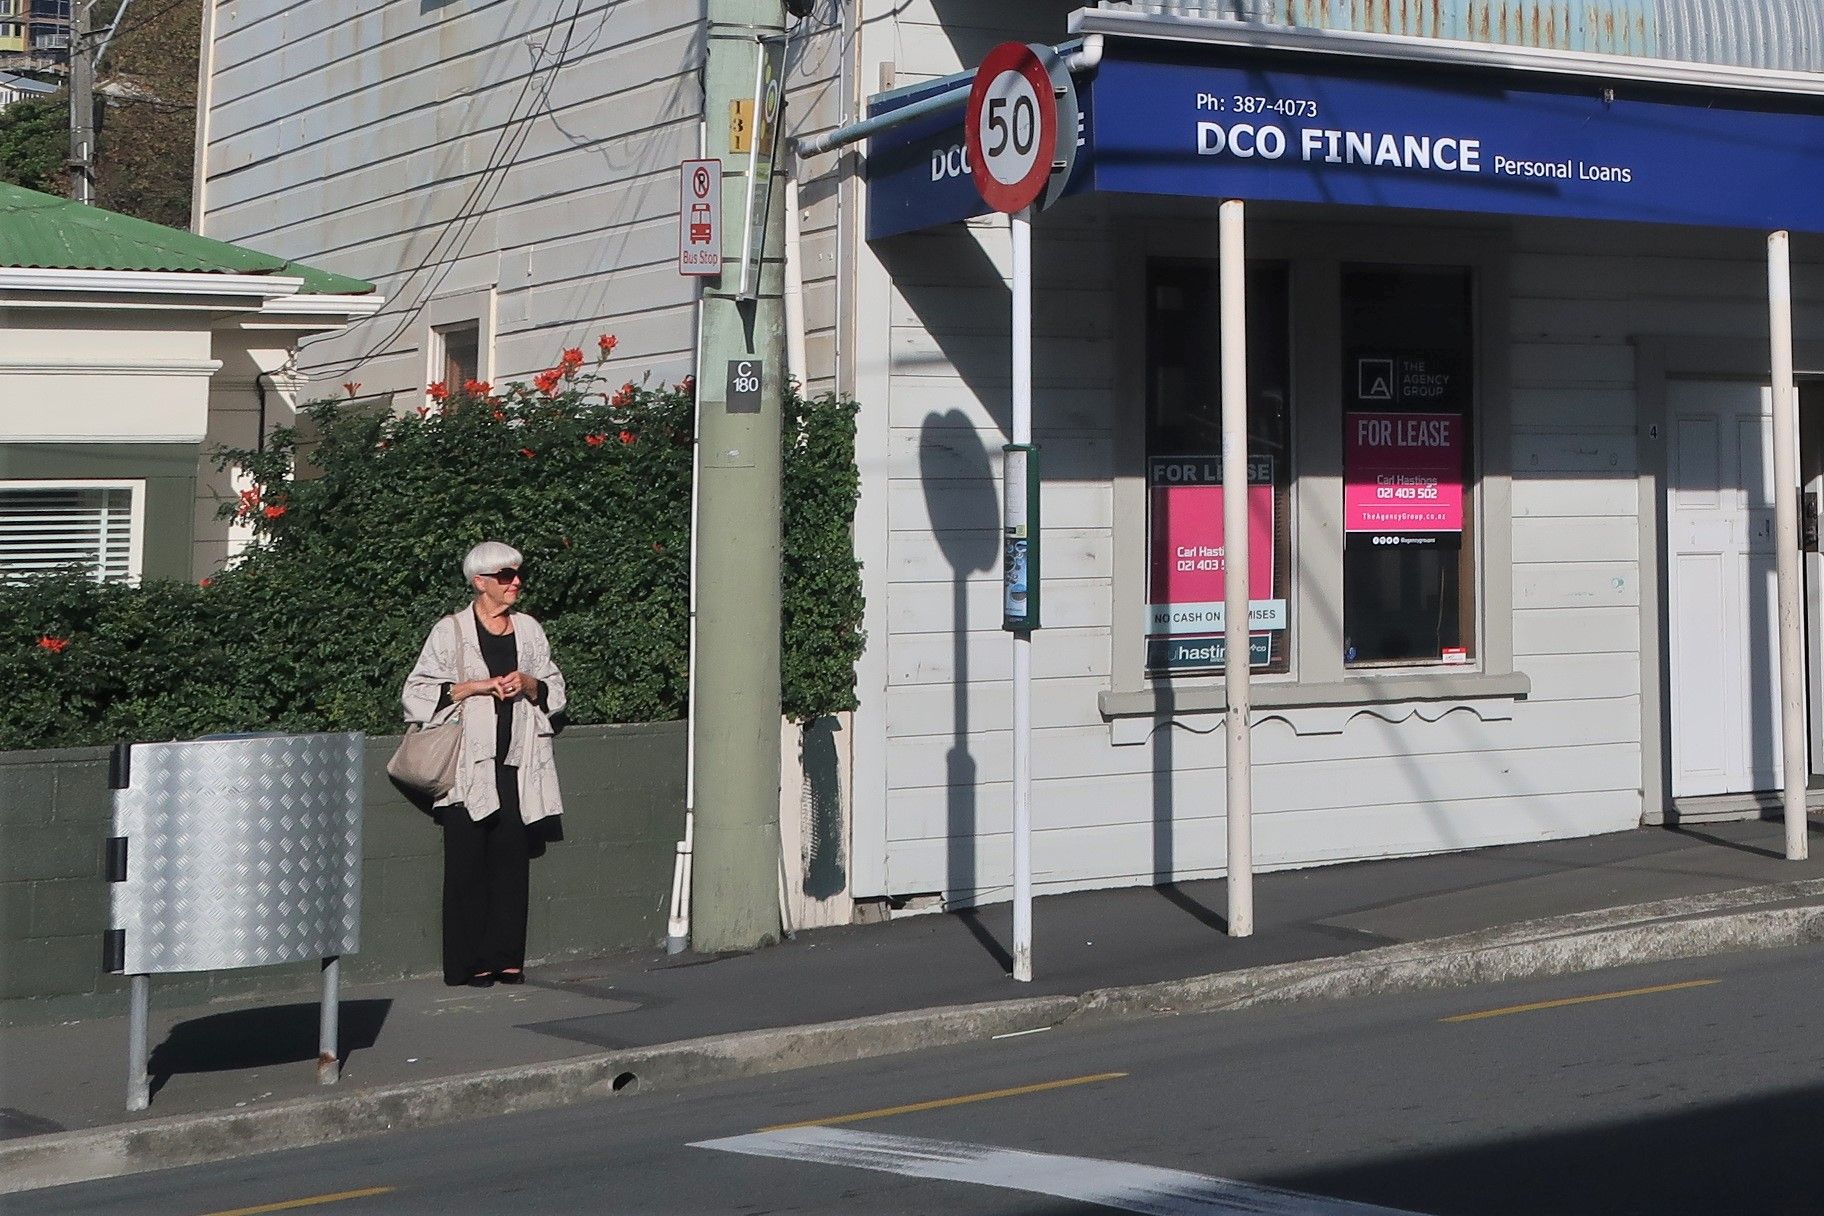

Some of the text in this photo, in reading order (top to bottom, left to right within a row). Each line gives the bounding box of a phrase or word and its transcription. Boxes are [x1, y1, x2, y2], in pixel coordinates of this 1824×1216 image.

[1197, 94, 1317, 117] Ph: 387-4073
[988, 95, 1035, 157] 50
[1197, 121, 1631, 183] DCO FINANCE Personal Loans
[683, 251, 718, 266] Bus Stop
[738, 361, 752, 377] C
[1403, 361, 1425, 372] THE
[733, 377, 759, 393] 180
[1403, 375, 1450, 385] AGENCY
[1403, 386, 1443, 397] GROUP
[1358, 419, 1450, 447] FOR LEASE
[1153, 464, 1197, 482] FOR
[1377, 474, 1438, 488] Carl Hastings
[1377, 488, 1438, 499] 021 403 502
[1177, 545, 1225, 557] Carl Hasti
[1177, 560, 1195, 571] 021
[1197, 559, 1219, 570] 403
[1155, 614, 1170, 624] NO
[1173, 613, 1202, 623] CASH
[1205, 612, 1221, 622] ON
